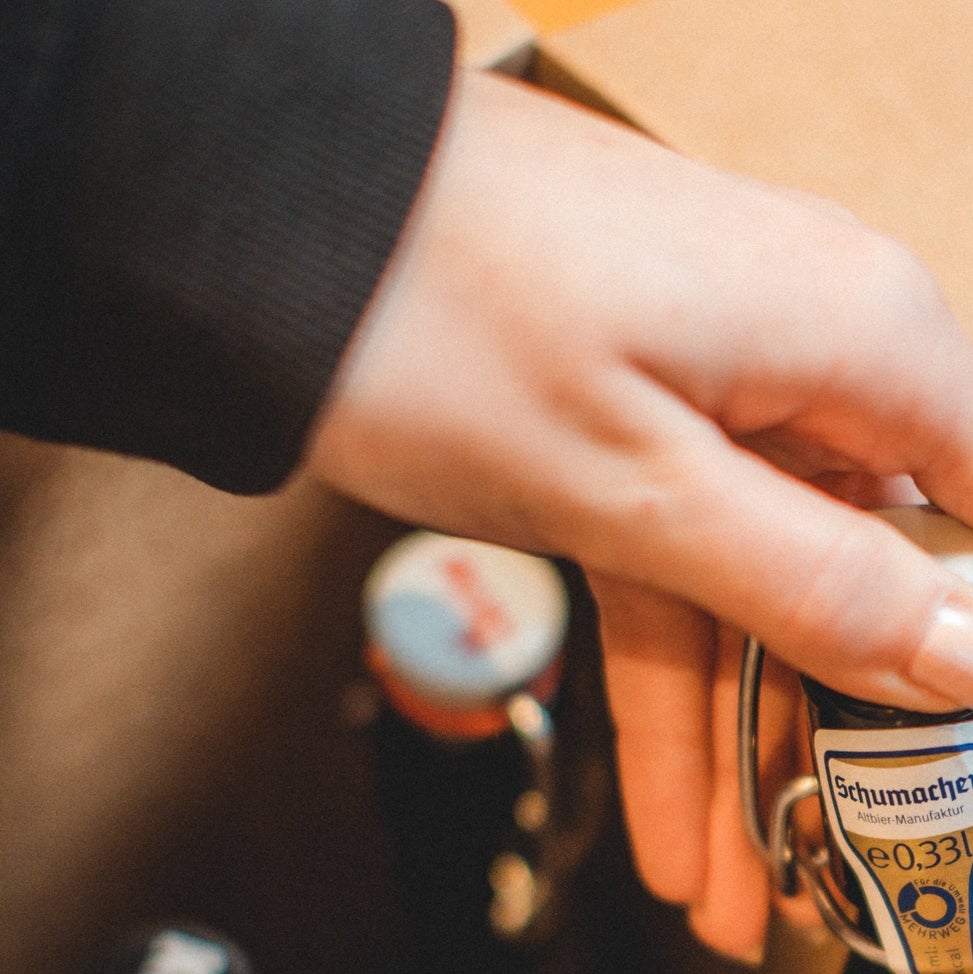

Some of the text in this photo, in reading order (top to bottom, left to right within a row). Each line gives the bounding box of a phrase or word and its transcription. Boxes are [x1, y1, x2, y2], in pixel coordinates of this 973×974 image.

[857, 805, 965, 825] Altbier-Manufaktur
[933, 878, 947, 887] die
[899, 913, 966, 940] MEHRWEG
